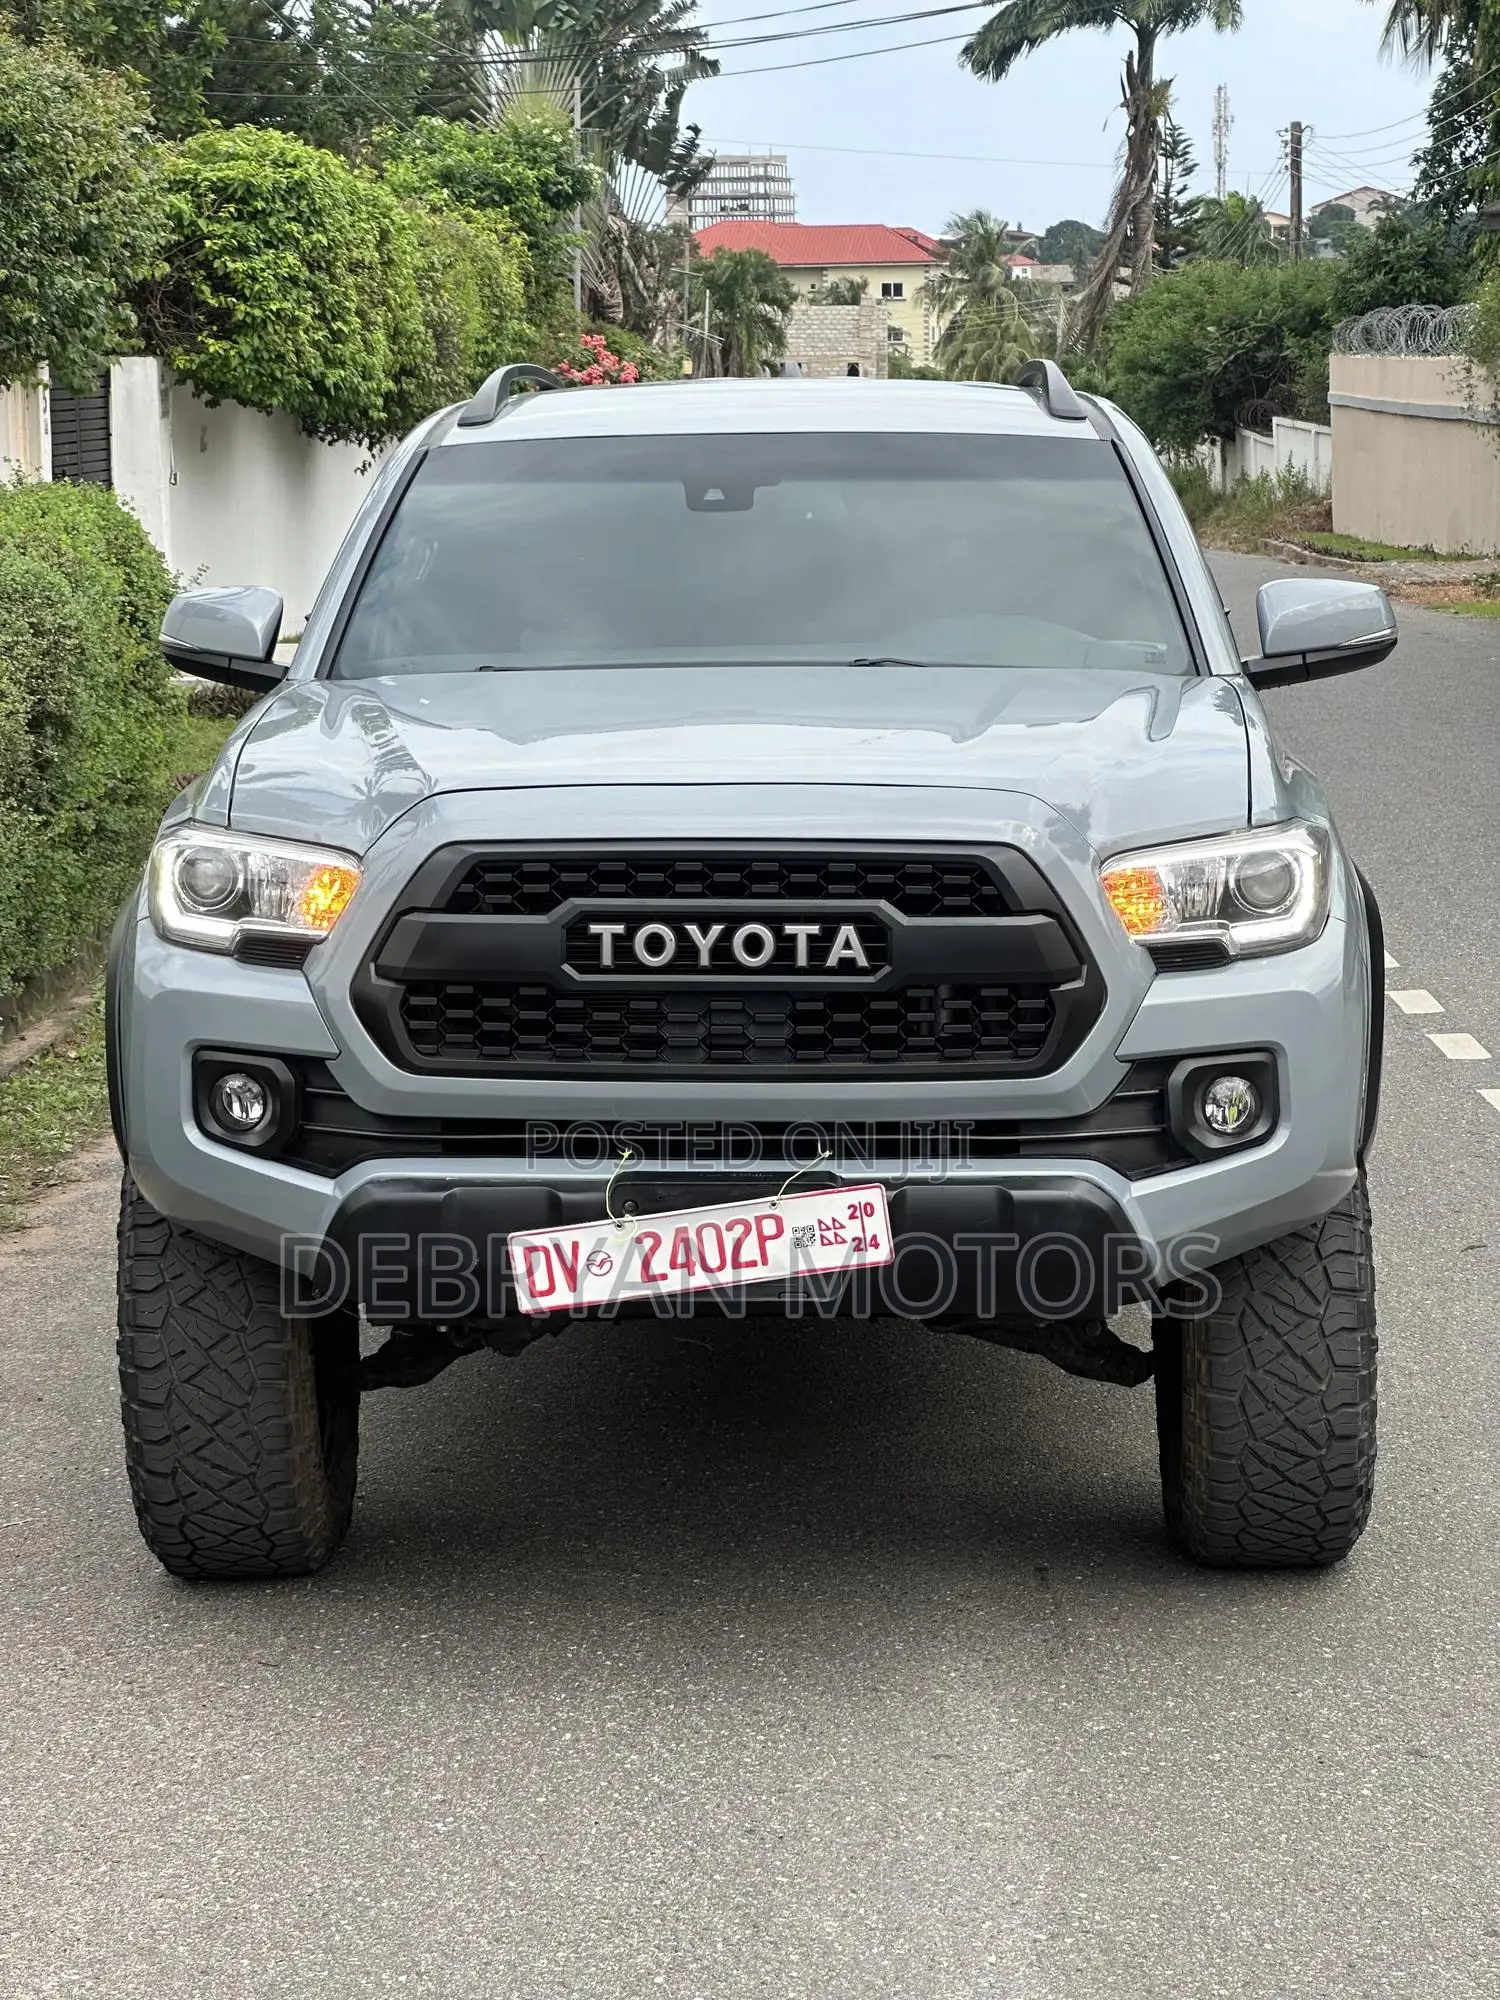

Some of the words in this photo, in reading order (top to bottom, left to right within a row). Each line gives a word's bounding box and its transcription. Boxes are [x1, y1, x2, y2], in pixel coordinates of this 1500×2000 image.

[588, 923, 870, 969] TOYOTA
[523, 1240, 579, 1298] DV
[635, 1214, 784, 1282] 2402P
